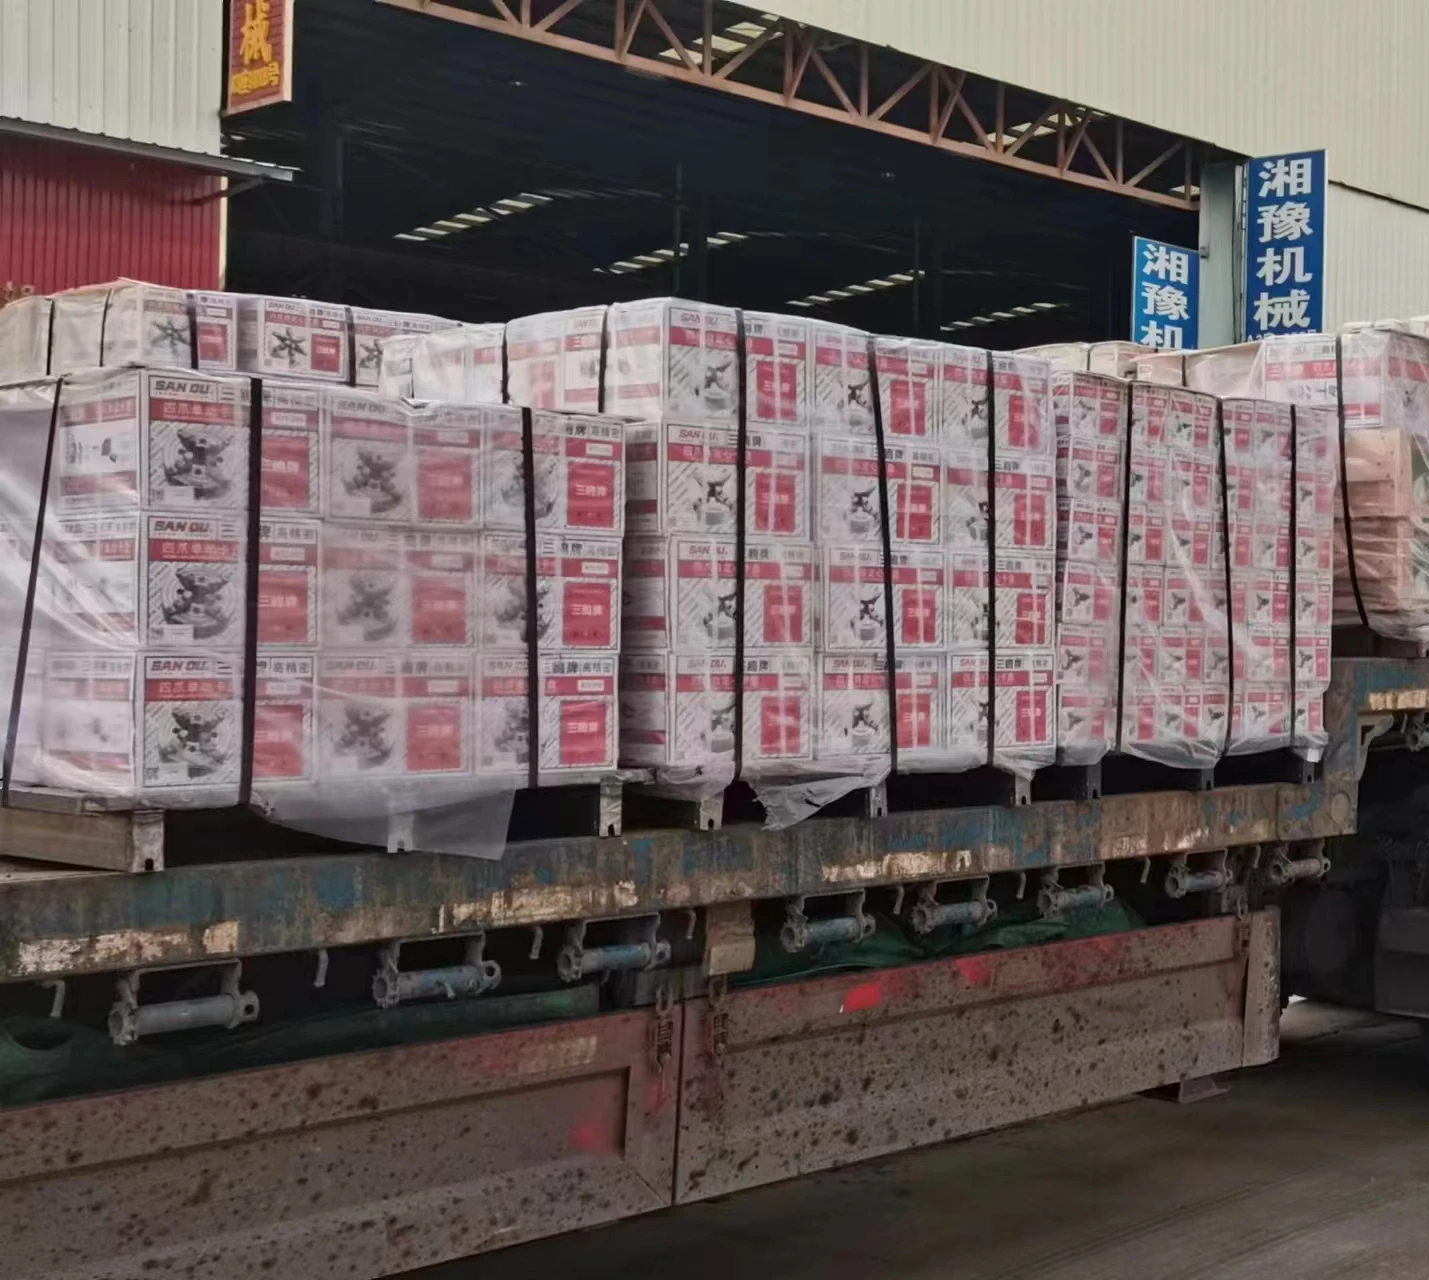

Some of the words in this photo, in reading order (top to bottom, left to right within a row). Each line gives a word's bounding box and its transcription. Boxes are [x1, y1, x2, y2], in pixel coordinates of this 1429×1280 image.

[1253, 157, 1313, 331] 湘豫机械
[1141, 243, 1191, 350] 湘豫机
[155, 380, 187, 392] SAN
[154, 520, 187, 532] SAN
[151, 660, 184, 671] SAN
